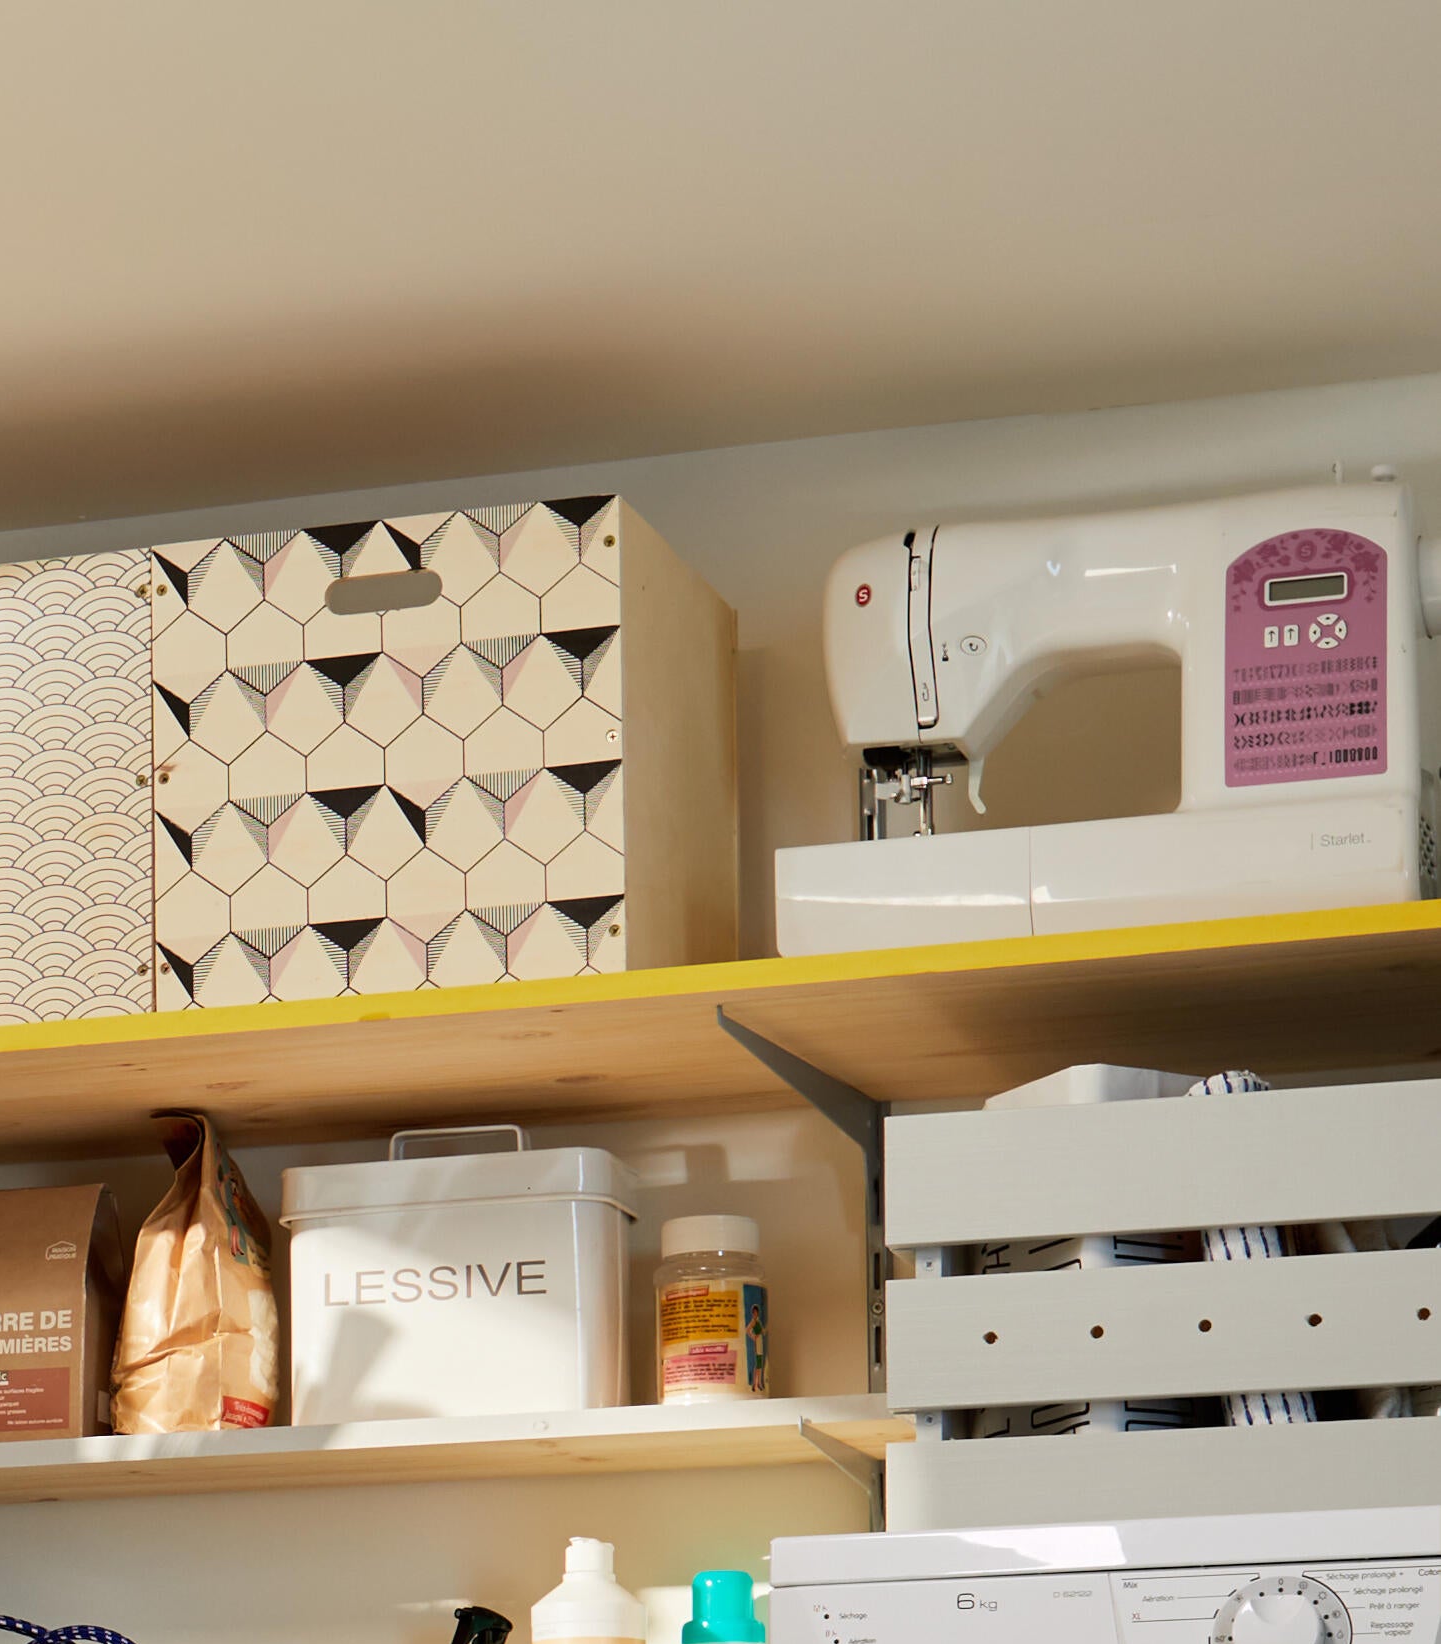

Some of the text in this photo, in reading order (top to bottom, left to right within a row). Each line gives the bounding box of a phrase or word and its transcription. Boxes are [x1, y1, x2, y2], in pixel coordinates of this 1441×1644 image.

[1320, 831, 1365, 848] Starlet
[322, 1259, 549, 1309] LESSIVE
[39, 1309, 73, 1331] DE
[1325, 1569, 1398, 1581] Séchage prolongé
[1122, 1581, 1139, 1590] Mix
[1352, 1584, 1425, 1596] Séchage prolongé
[956, 1592, 998, 1612] 6 kg
[1368, 1601, 1421, 1612] Prêt ranger
[1369, 1620, 1415, 1631] Repassage
[1383, 1628, 1413, 1638] vapeur
